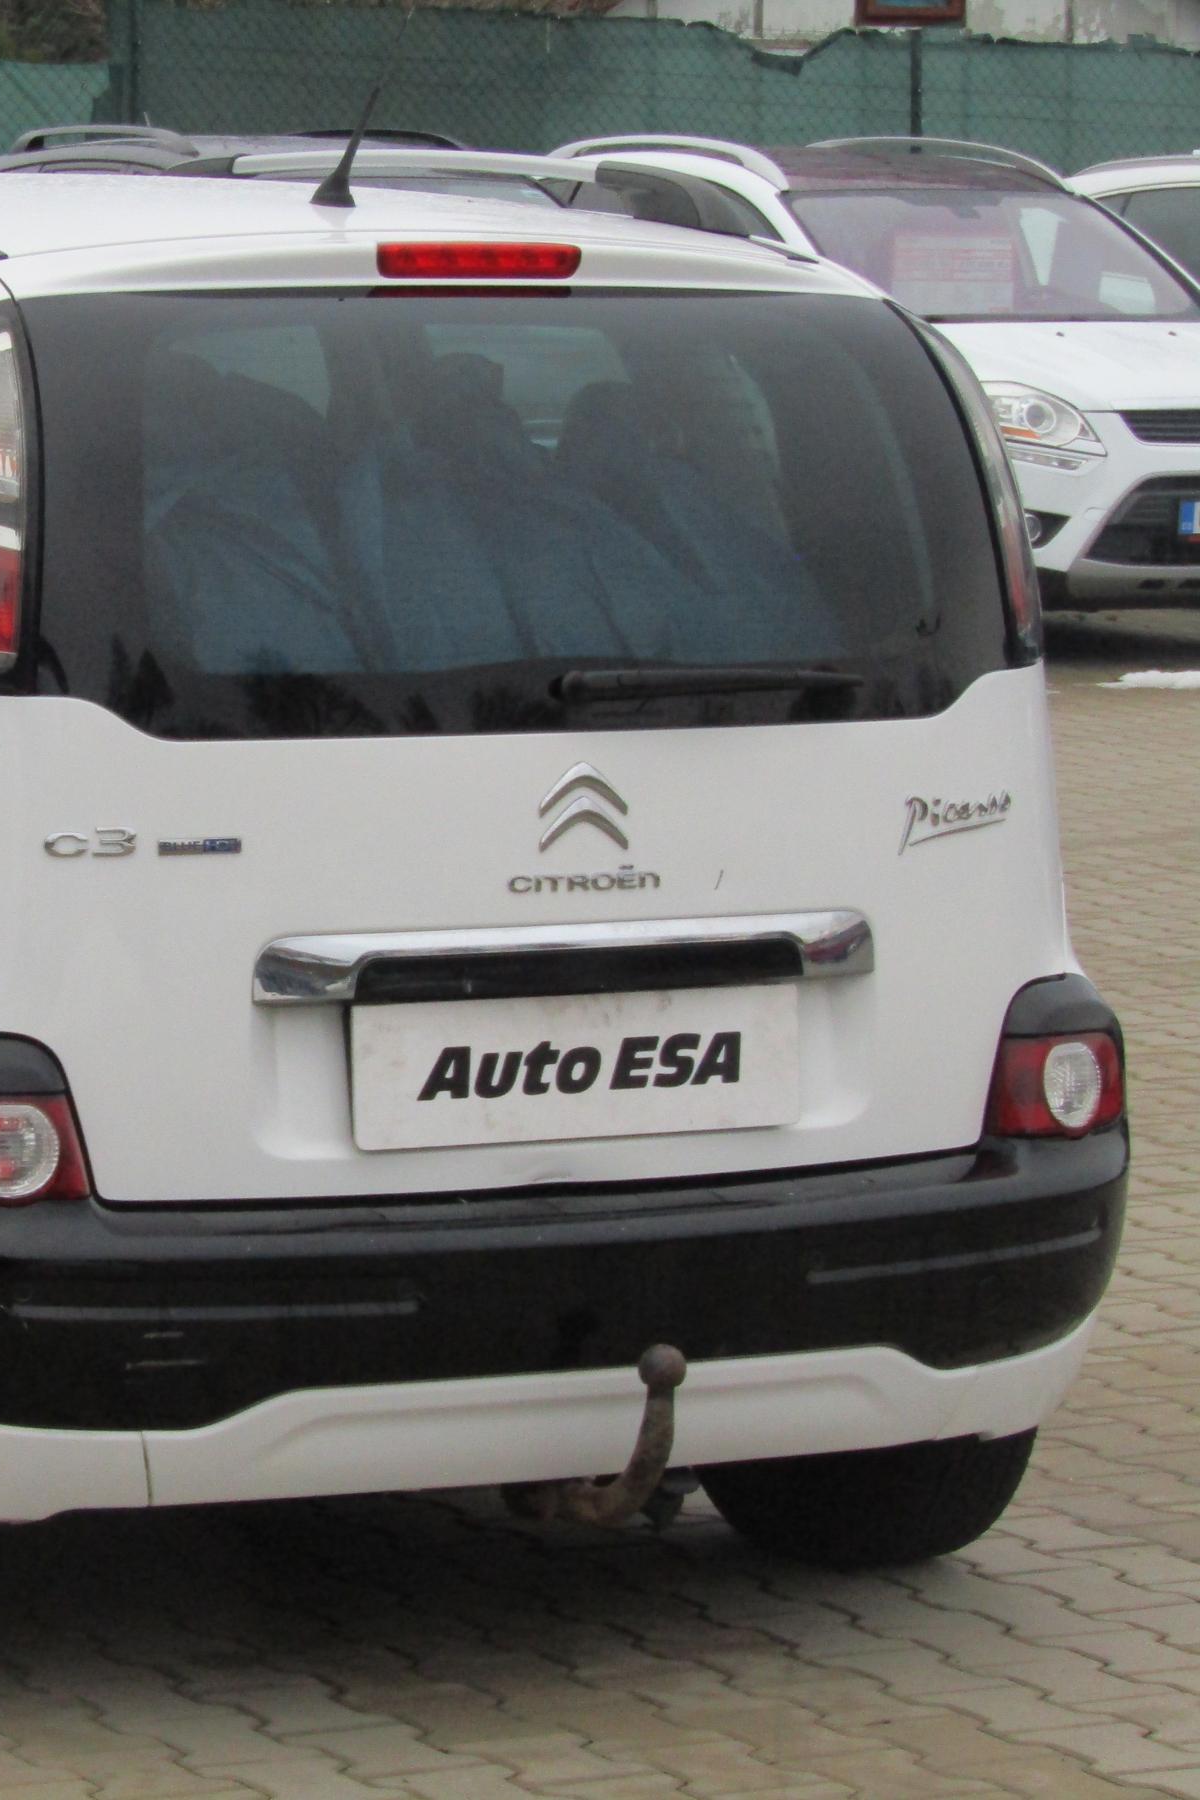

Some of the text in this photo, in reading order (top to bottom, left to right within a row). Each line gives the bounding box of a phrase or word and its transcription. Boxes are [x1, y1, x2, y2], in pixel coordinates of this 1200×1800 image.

[44, 827, 137, 858] C3
[416, 1031, 742, 1101] Auto ESA
